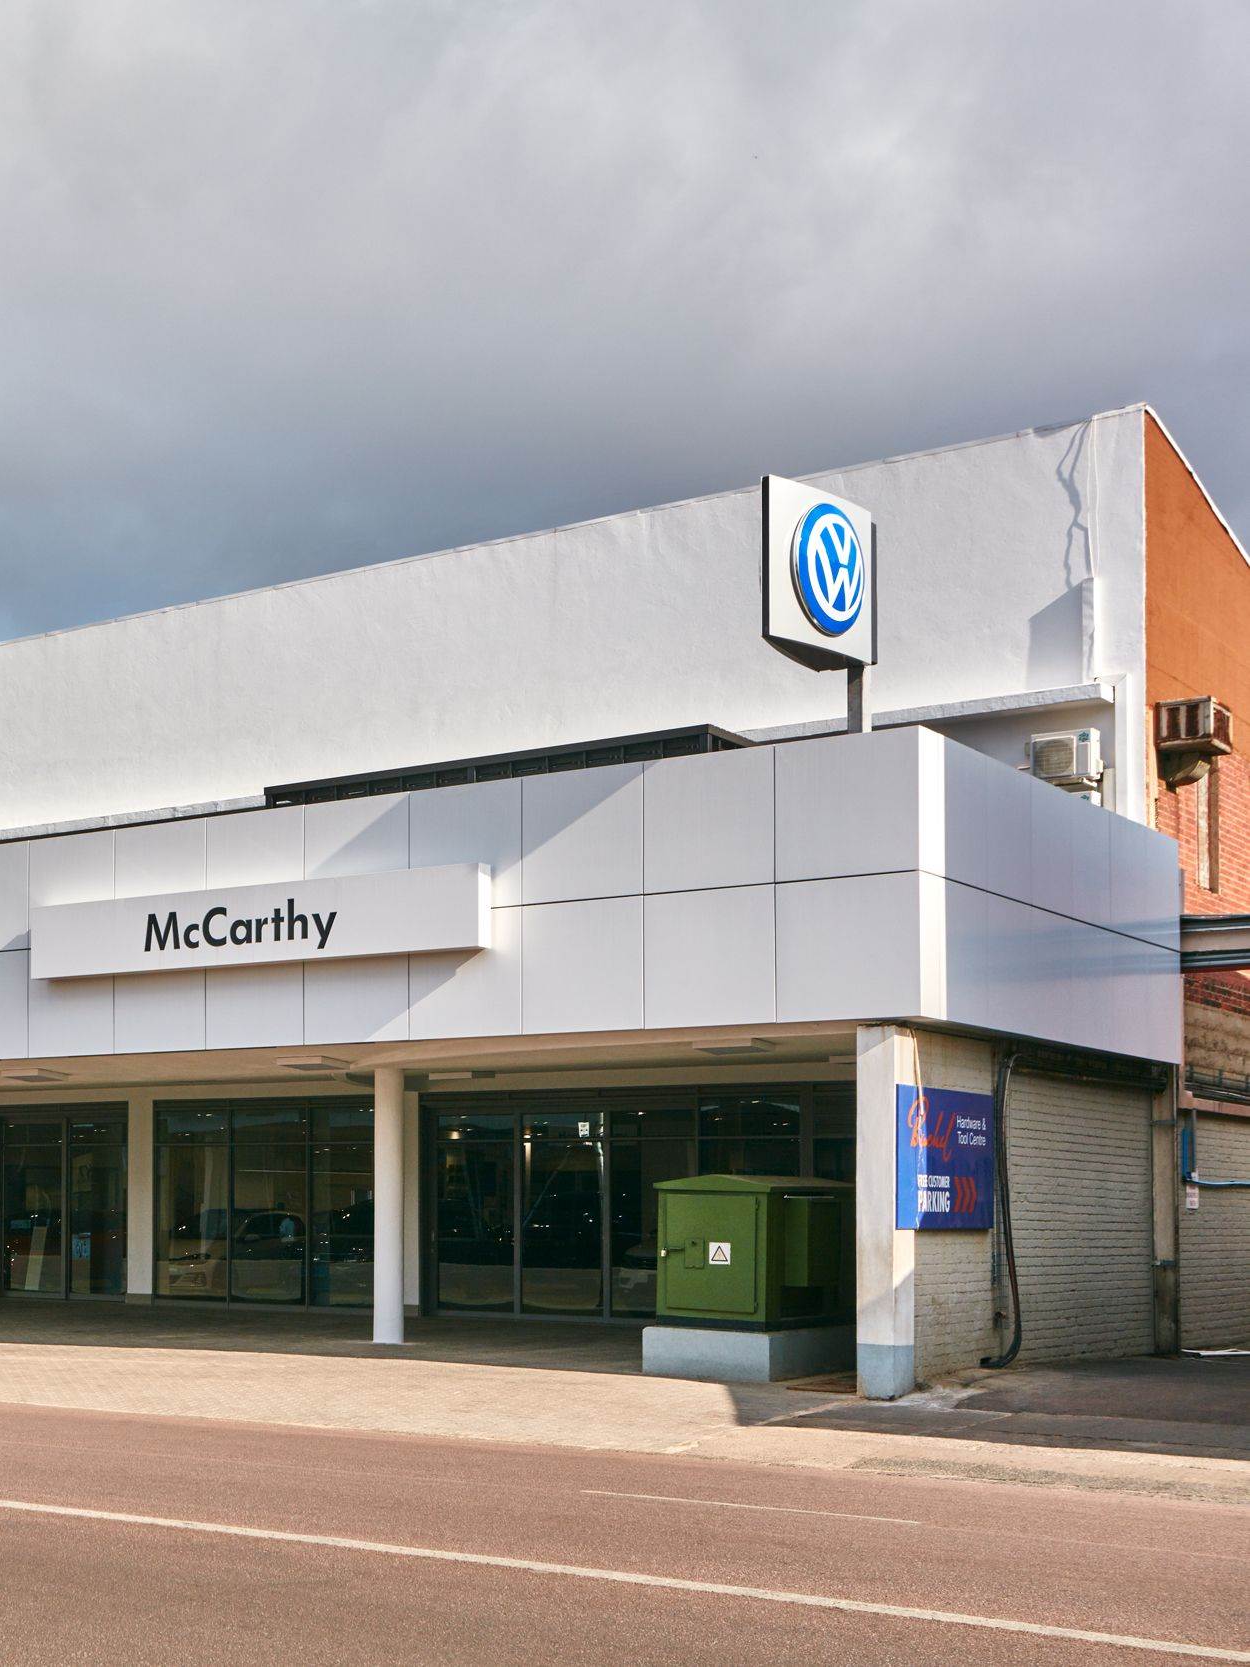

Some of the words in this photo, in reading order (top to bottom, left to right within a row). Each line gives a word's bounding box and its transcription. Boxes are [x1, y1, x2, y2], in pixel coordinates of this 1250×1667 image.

[144, 898, 338, 952] McCarthy
[956, 1115, 981, 1130] Hardware
[982, 1117, 987, 1131] &
[957, 1132, 968, 1144] Tool
[969, 1132, 987, 1146] Centre
[917, 1174, 928, 1188] FREE
[928, 1175, 950, 1188] CUSTOMER
[917, 1190, 951, 1213] PARKING
